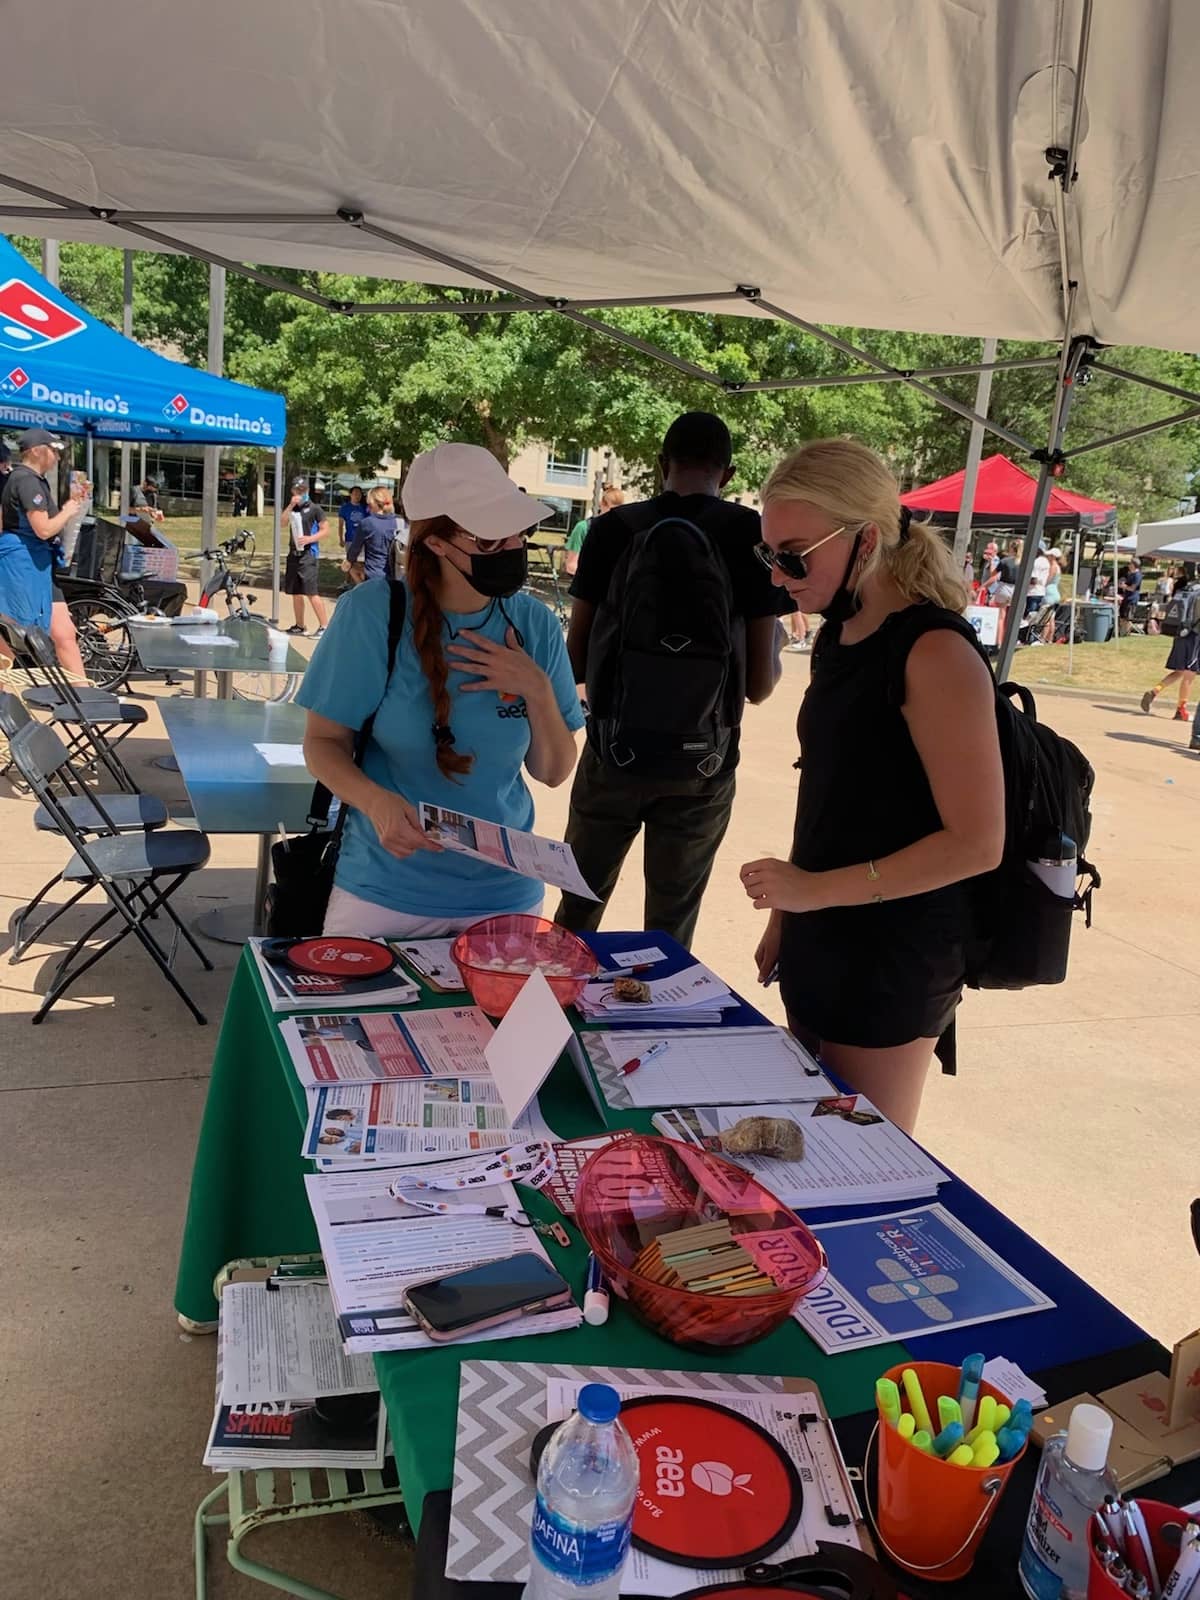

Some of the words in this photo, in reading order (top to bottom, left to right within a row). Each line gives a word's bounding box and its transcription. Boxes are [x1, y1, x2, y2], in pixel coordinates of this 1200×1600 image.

[31, 382, 129, 415] Domino's
[190, 407, 273, 436] Domino's
[529, 1168, 548, 1187] aea
[876, 1230, 928, 1277] Healthcare
[224, 1413, 295, 1435] SPRING
[655, 1445, 686, 1498] aea
